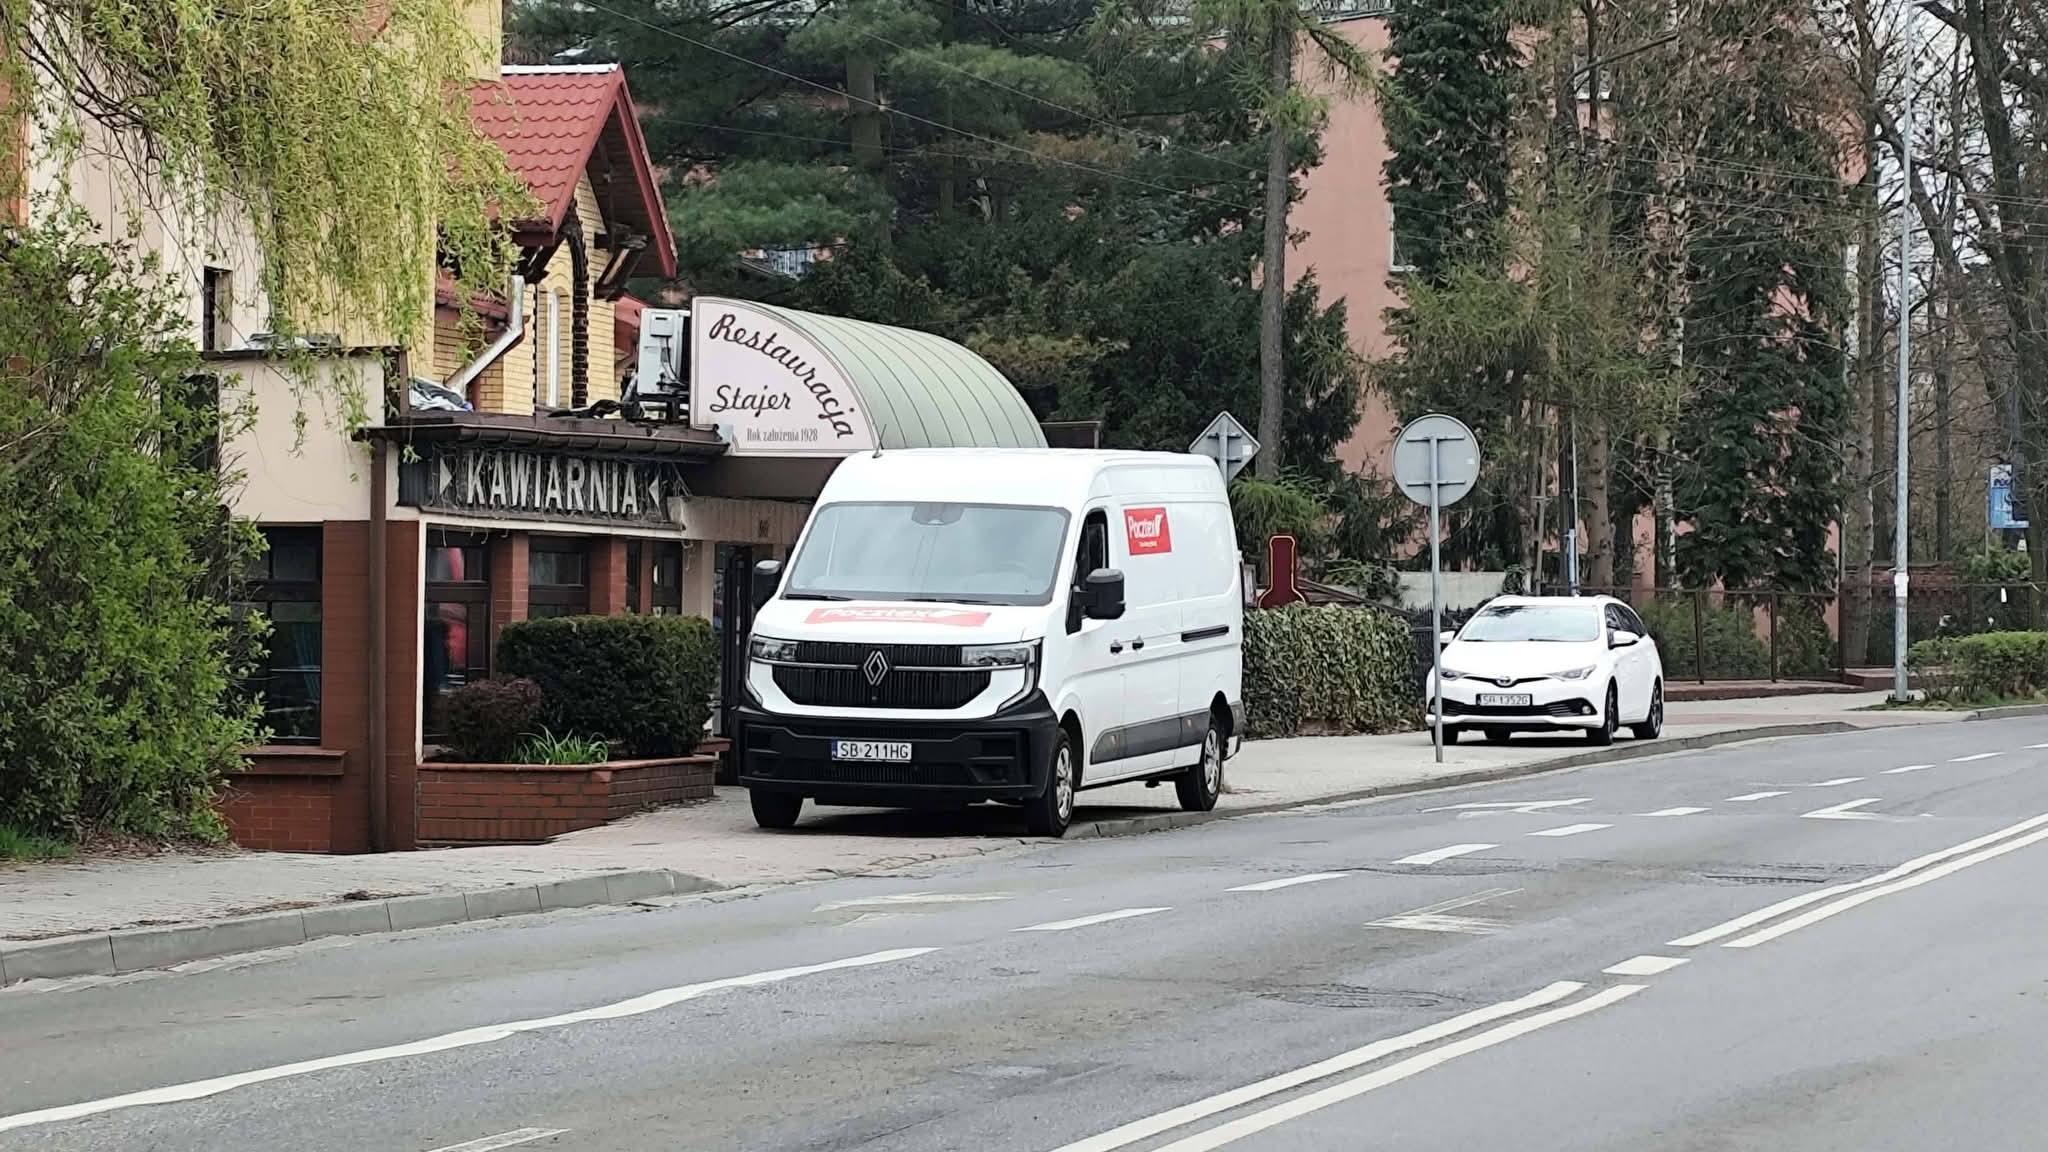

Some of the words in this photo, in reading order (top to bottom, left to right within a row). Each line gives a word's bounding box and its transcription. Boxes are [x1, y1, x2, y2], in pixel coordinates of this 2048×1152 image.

[709, 313, 854, 438] Restauracja
[709, 384, 792, 418] Stajer
[747, 427, 761, 441] Rok
[801, 428, 818, 442] 1928
[467, 450, 639, 514] KAWIARNIA
[840, 742, 859, 757] SB
[864, 743, 909, 759] 211HG
